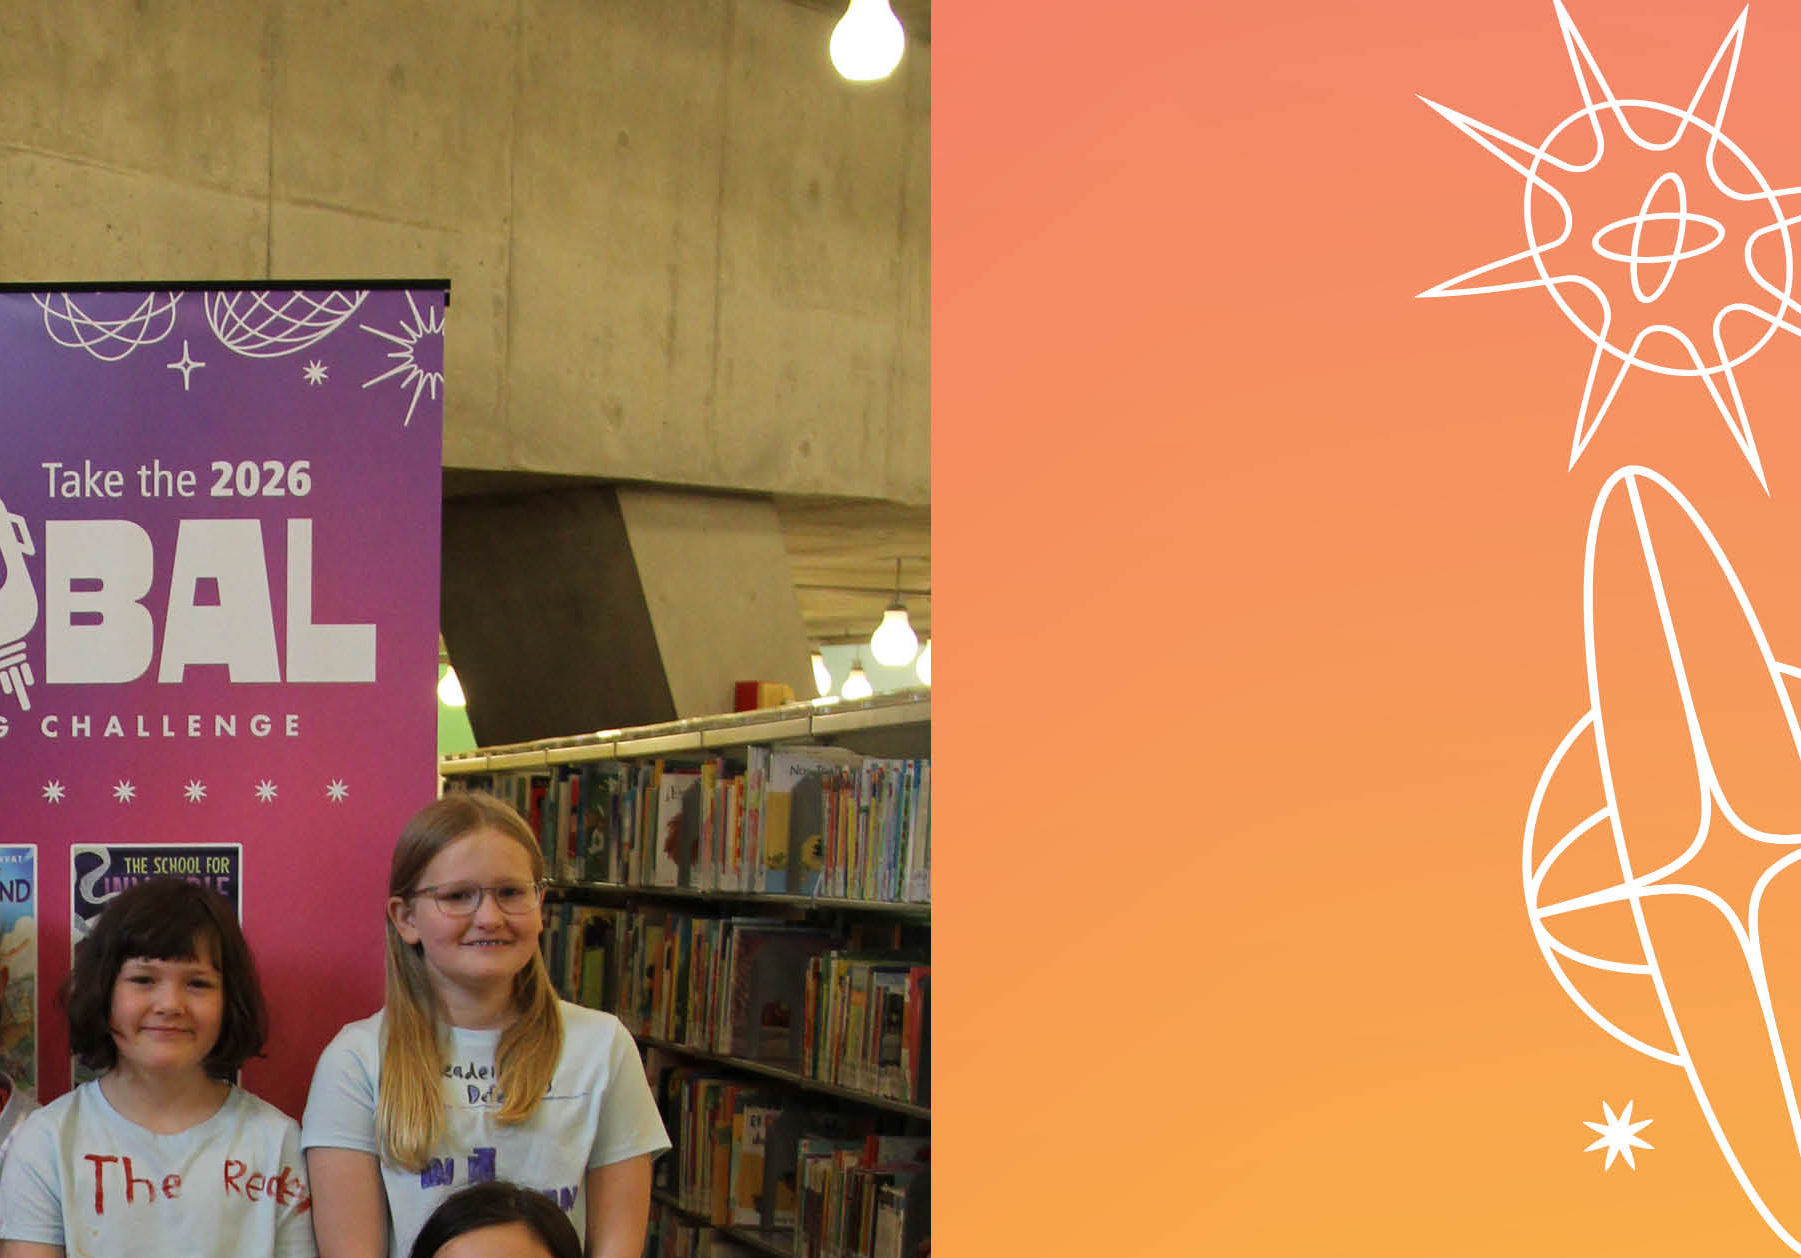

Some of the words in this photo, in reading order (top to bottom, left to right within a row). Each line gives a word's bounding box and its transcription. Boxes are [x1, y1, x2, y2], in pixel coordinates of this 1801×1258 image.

[42, 461, 124, 498] Take
[137, 459, 197, 498] the
[209, 460, 312, 498] 2026
[41, 713, 301, 738] CHALLENGE
[124, 857, 148, 874] THE
[153, 856, 200, 874] SCHOOL
[206, 856, 230, 874] FOR
[84, 1154, 182, 1216] The
